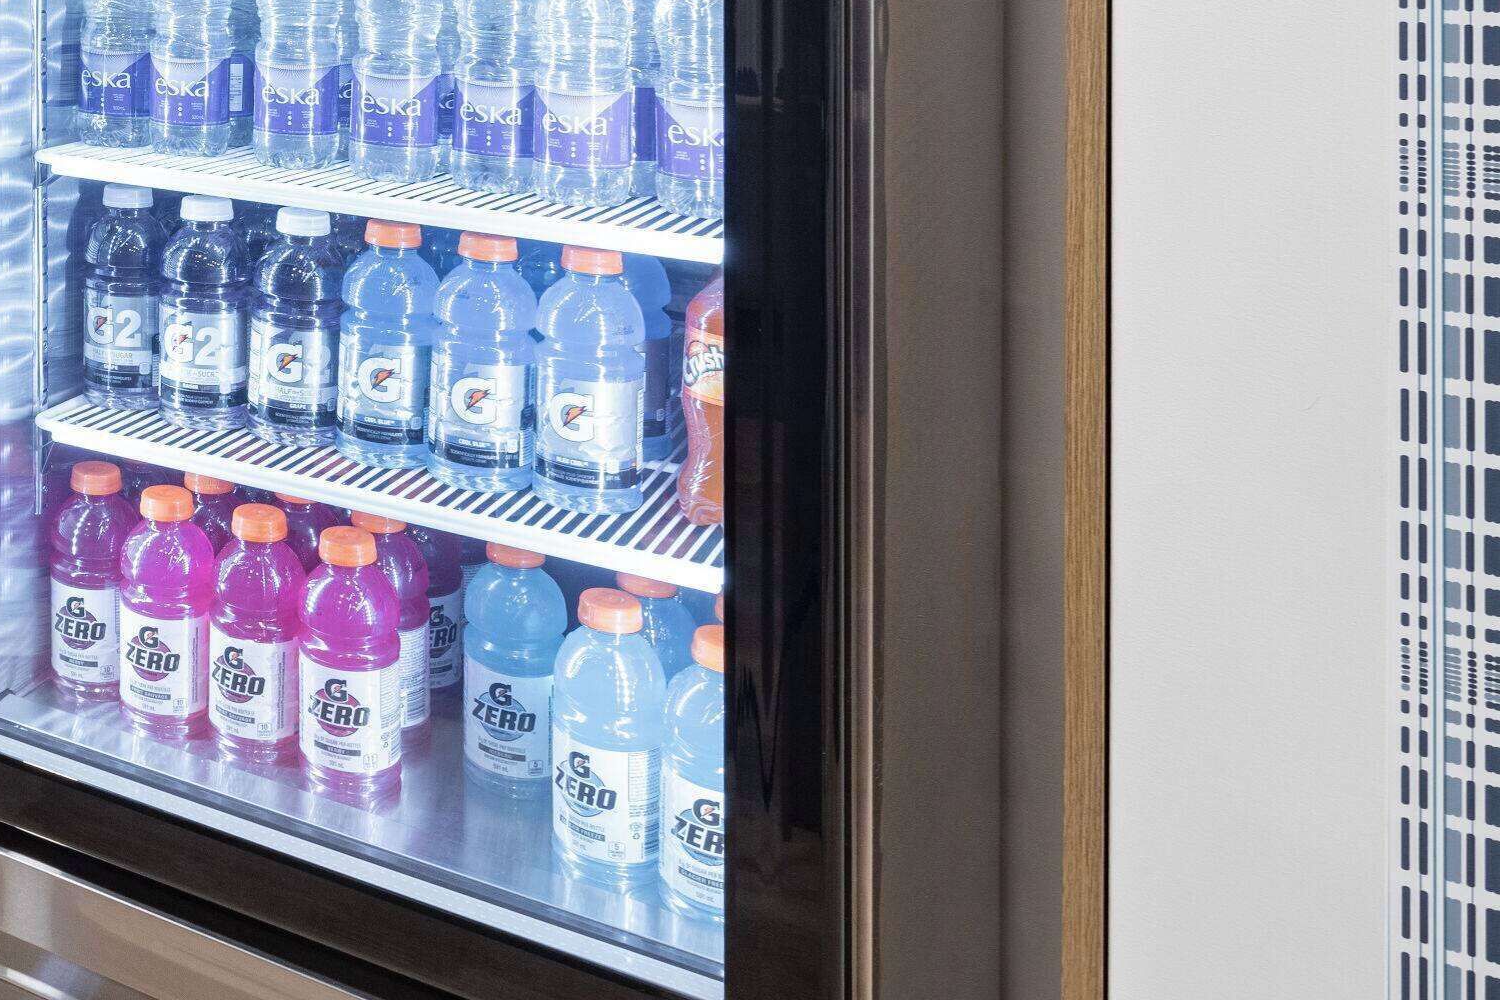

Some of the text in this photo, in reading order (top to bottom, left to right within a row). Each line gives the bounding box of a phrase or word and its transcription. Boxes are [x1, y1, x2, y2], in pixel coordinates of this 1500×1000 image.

[81, 69, 132, 89] eska
[155, 75, 210, 98] eska
[262, 82, 320, 105] eska
[363, 90, 421, 117] eska
[459, 102, 522, 126] eska
[542, 112, 607, 137] eska
[86, 307, 142, 347] G2
[164, 324, 223, 366] G2
[358, 357, 401, 403] G
[451, 377, 497, 425] G
[549, 392, 595, 442] G
[66, 596, 85, 618] G
[55, 613, 107, 641] ZERO
[139, 626, 159, 648] G
[125, 641, 181, 672] ZERO
[224, 646, 244, 670] G
[211, 661, 266, 696] ZERO
[324, 678, 348, 702] G
[488, 682, 512, 707] G
[308, 693, 371, 727] ZERO
[472, 697, 537, 733] ZERO
[569, 750, 590, 779] G
[555, 764, 617, 811] ZERO
[693, 798, 720, 827] G
[671, 814, 724, 855] ZER
